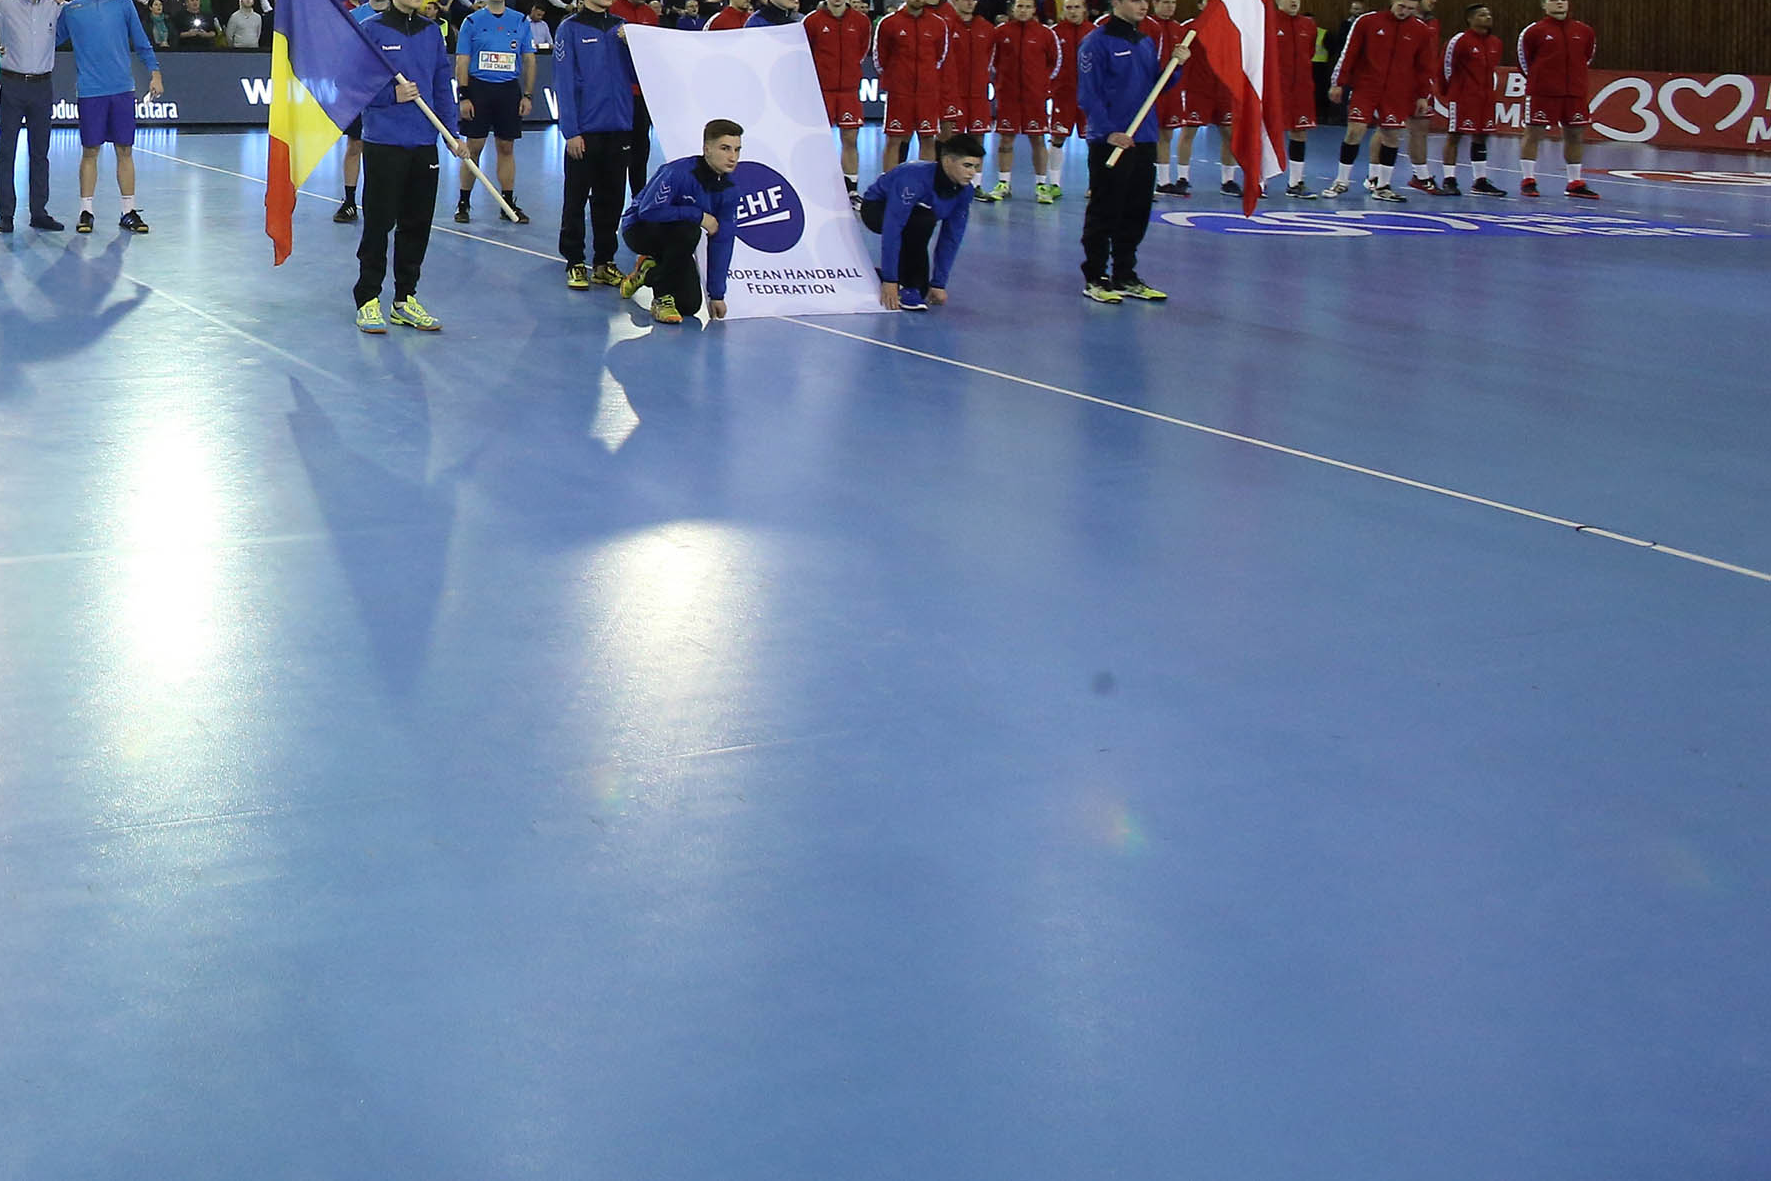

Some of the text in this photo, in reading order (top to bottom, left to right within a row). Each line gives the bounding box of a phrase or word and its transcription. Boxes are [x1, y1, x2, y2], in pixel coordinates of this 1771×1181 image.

[727, 268, 863, 280] ROPEAN HANDBALL
[747, 282, 837, 295] FEDERATION
